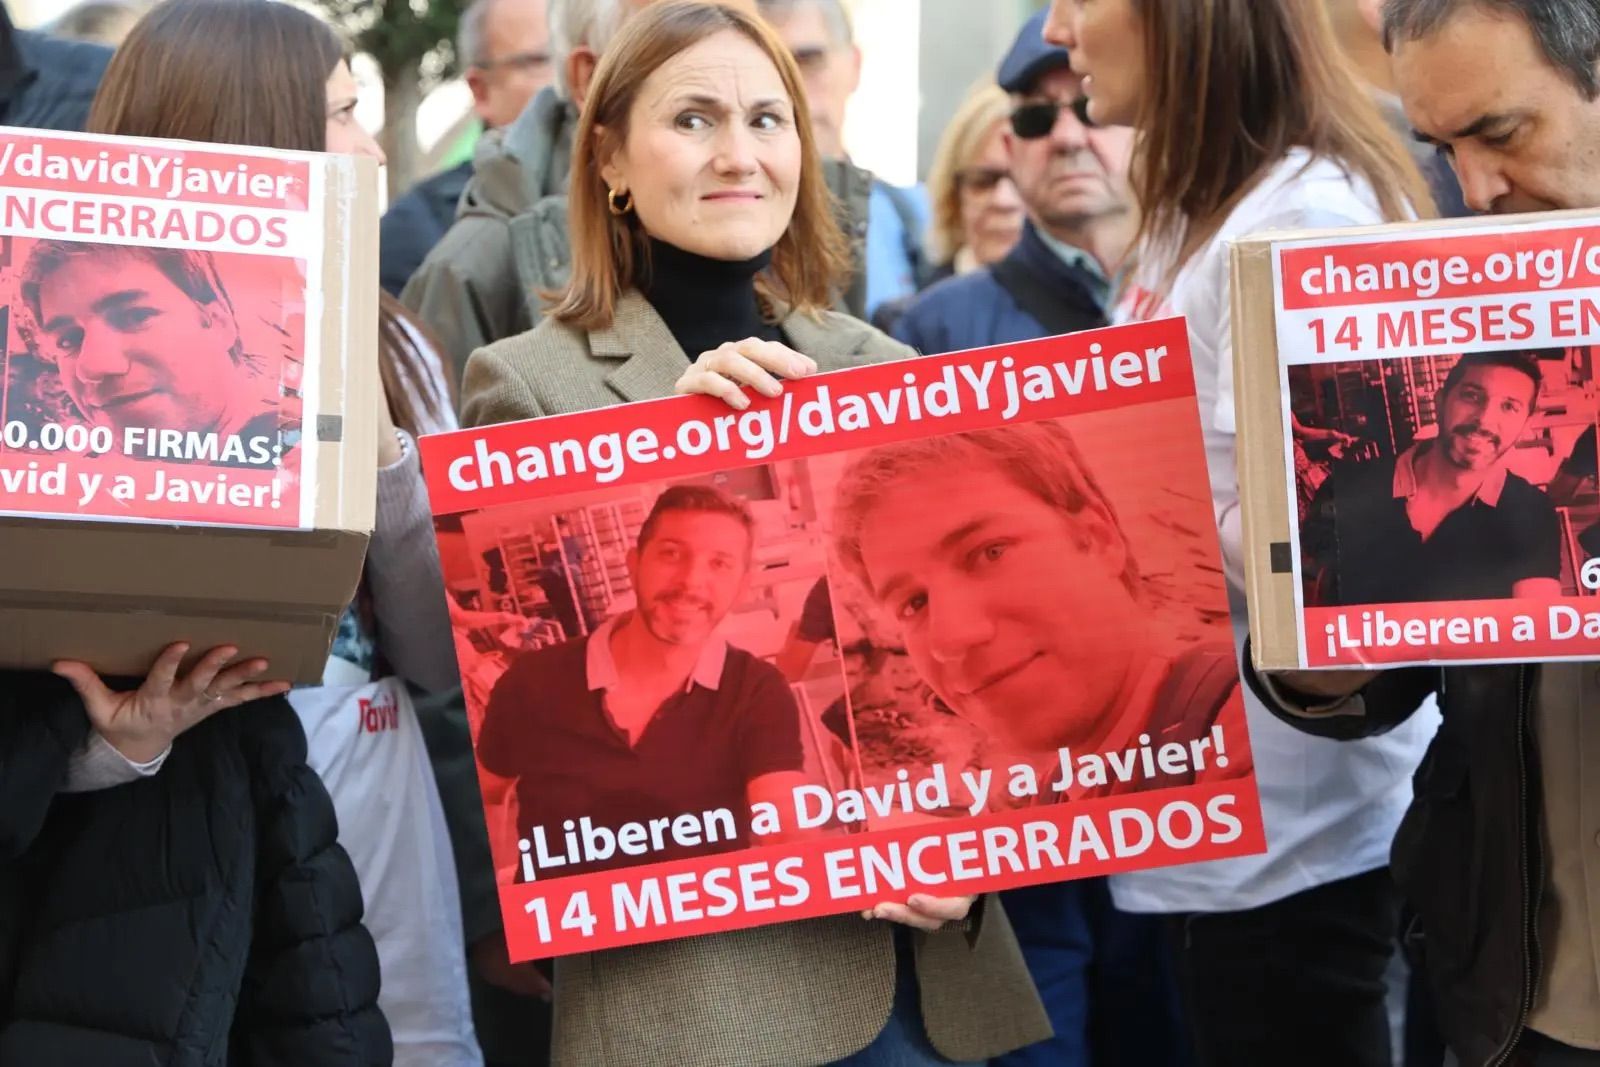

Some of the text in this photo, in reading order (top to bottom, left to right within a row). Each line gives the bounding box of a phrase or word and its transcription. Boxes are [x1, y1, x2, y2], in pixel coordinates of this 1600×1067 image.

[5, 195, 287, 248] NCERRADOS
[1307, 315, 1362, 354] 14
[1377, 302, 1535, 350] MESES
[0, 420, 282, 466] 0.000 FIRMAS:
[448, 343, 1168, 492] change.org/davidYjavier
[0, 461, 282, 509] vid y a Javier!
[1326, 610, 1499, 658] ¡Liberen
[1511, 615, 1536, 642] a
[518, 725, 1230, 882] ¡Liberen a David y a Javier!
[524, 794, 1243, 944] 14 MESES ENCERRADOS
